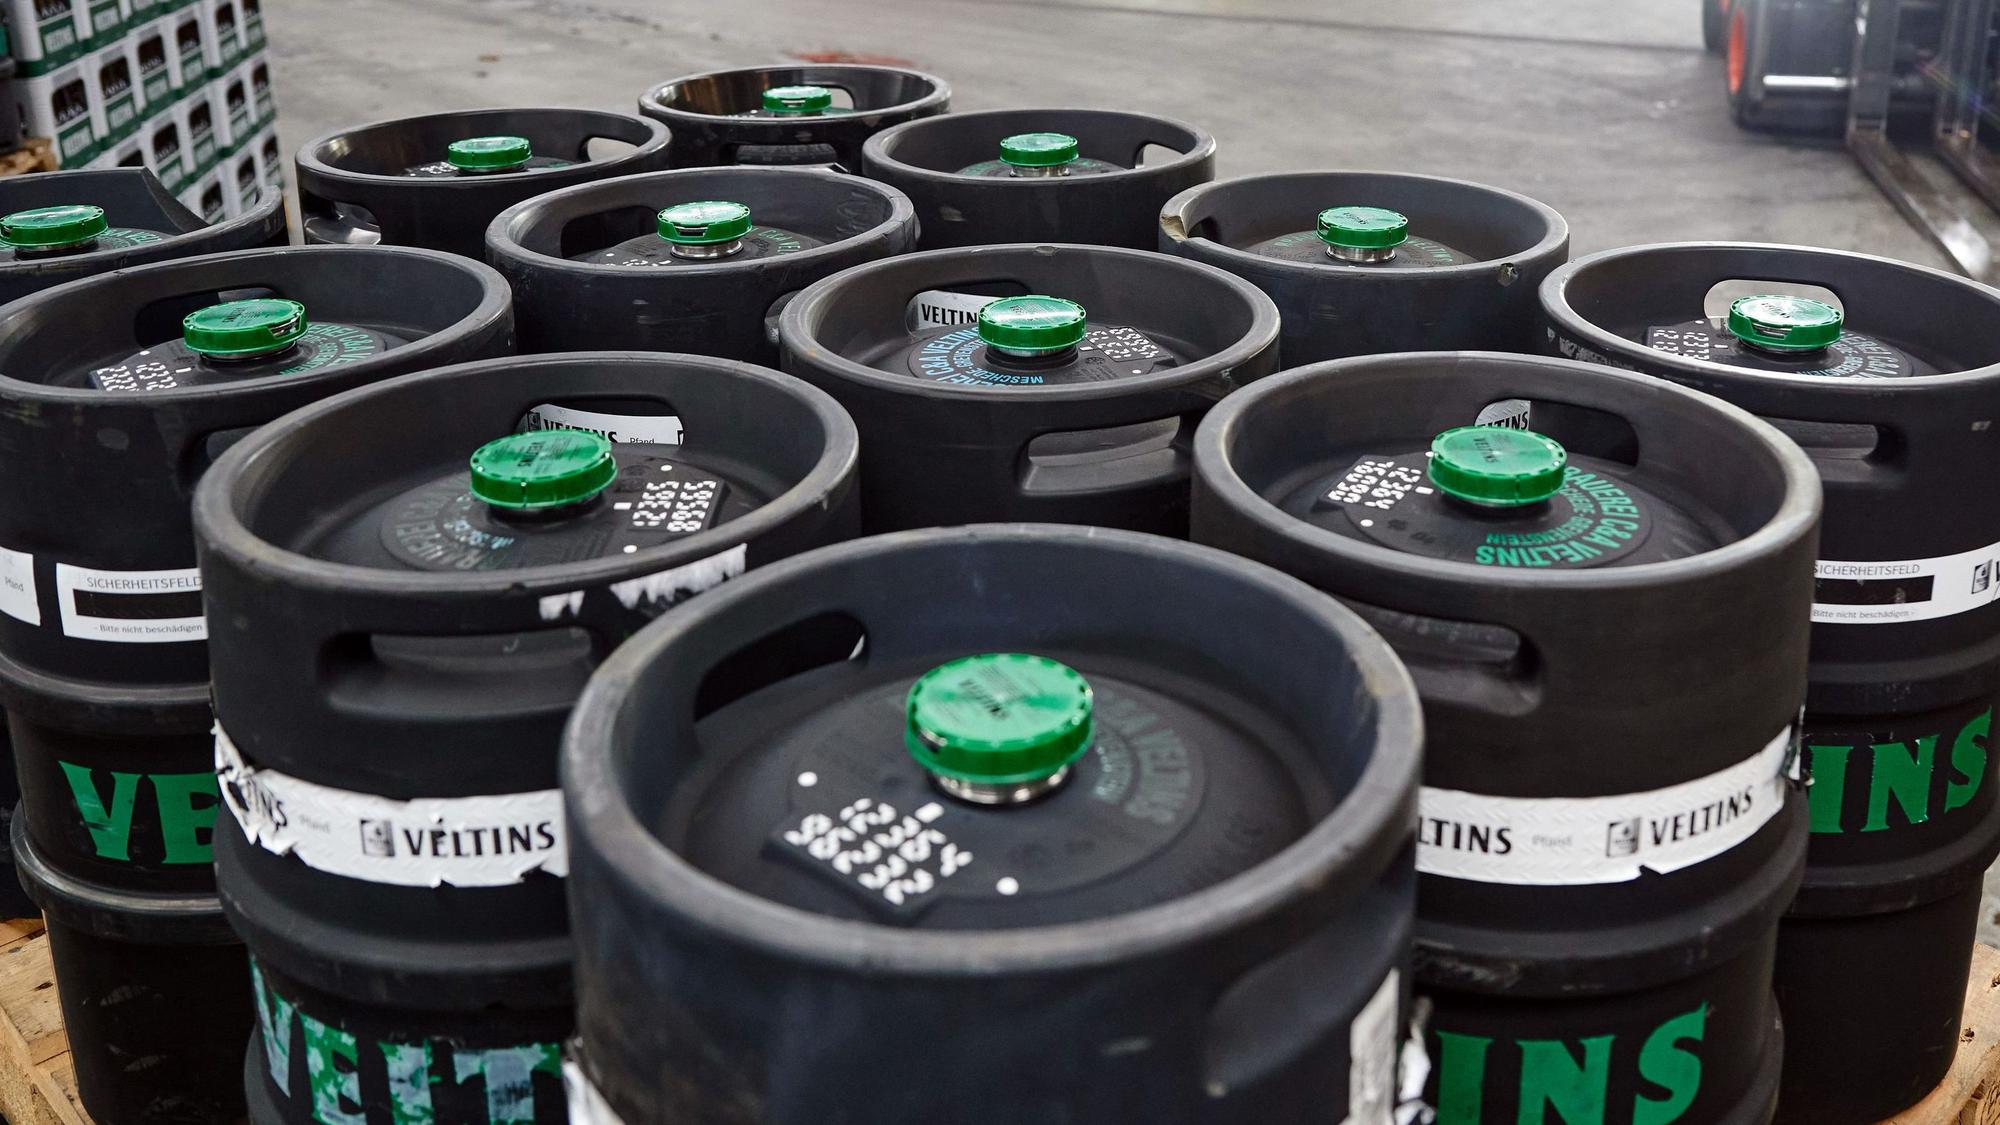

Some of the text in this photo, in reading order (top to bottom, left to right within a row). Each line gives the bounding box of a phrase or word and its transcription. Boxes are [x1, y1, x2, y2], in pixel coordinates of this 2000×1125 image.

[921, 303, 978, 325] VELTIN
[918, 356, 954, 376] C&A
[1587, 520, 1639, 551] C&A
[1475, 545, 1601, 568] VELTINS
[1807, 706, 1992, 833] INS
[57, 761, 219, 864] VE
[1417, 818, 1512, 855] LTINS
[1651, 785, 1754, 847] VELTINS
[405, 821, 555, 858] VELTINS
[1436, 1001, 1708, 1125] INS
